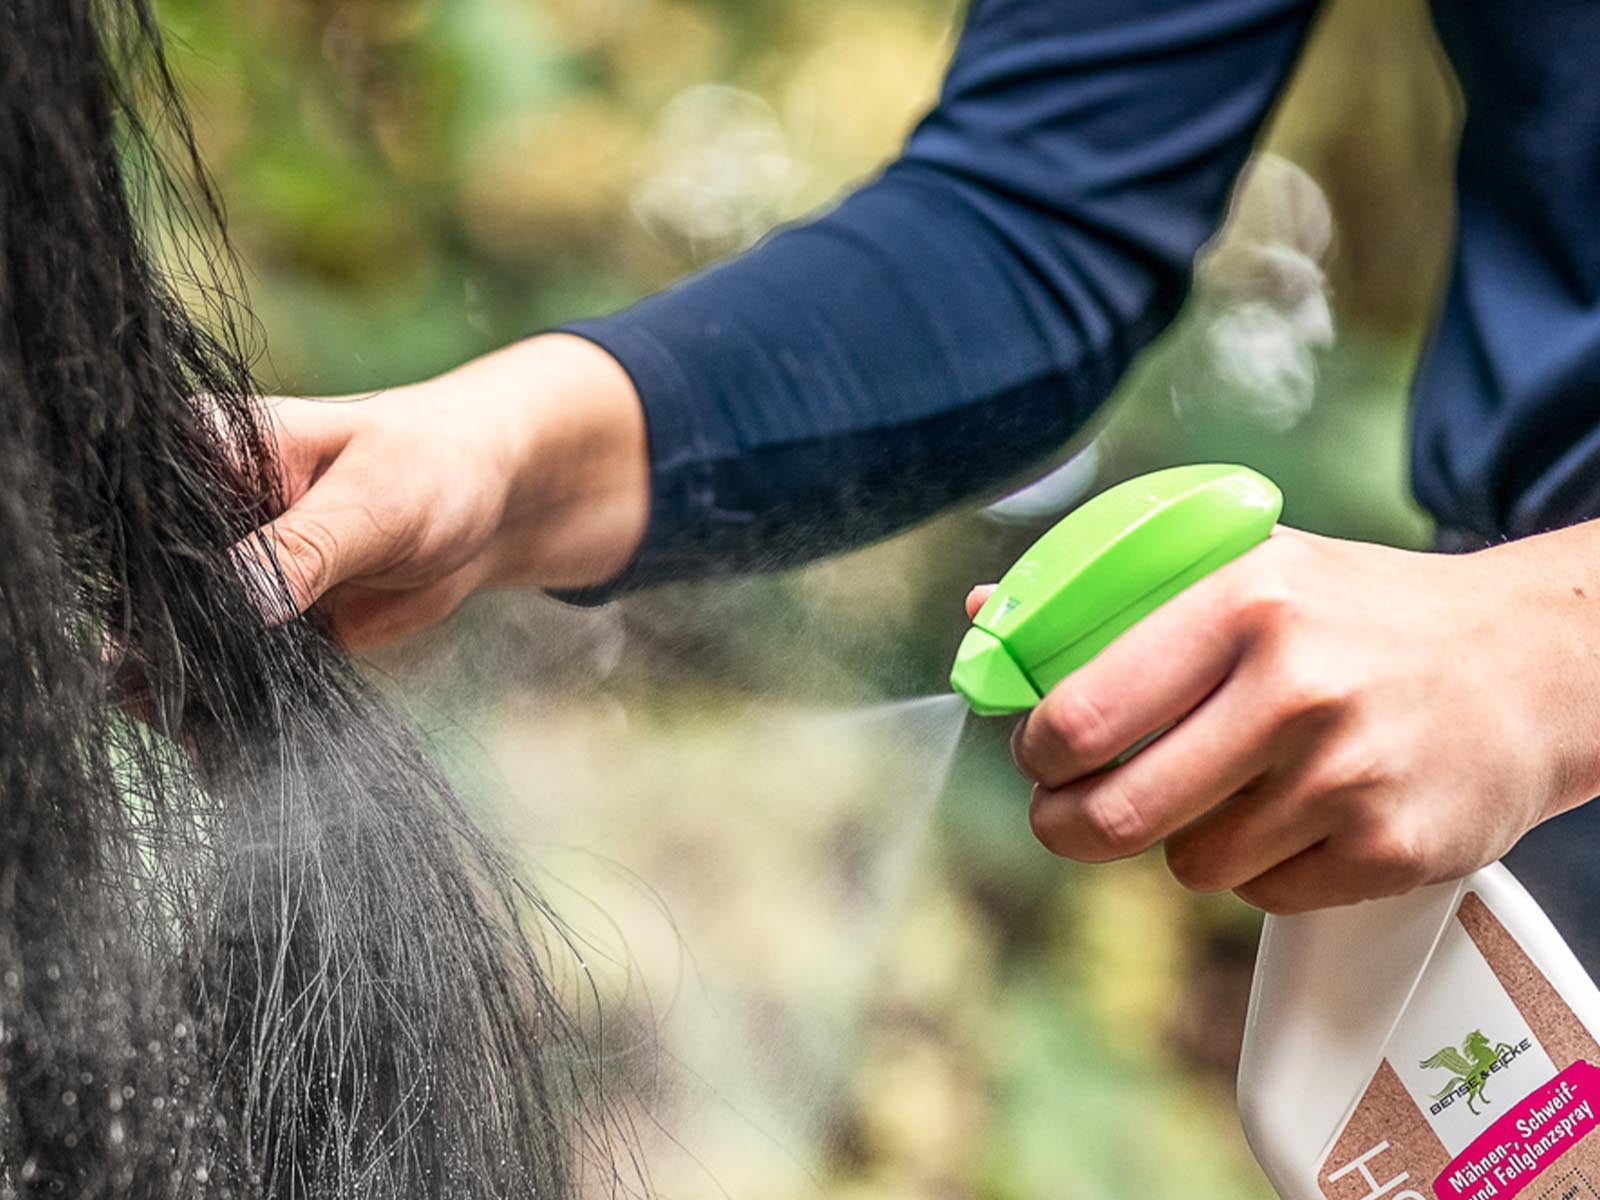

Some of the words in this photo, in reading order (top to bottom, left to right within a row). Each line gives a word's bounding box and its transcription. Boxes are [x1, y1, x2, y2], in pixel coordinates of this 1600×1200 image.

[1479, 1070, 1491, 1080] &
[1488, 1037, 1532, 1073] EICKE
[1448, 1141, 1520, 1193] Mähnen-,
[1516, 1081, 1578, 1138] Schweif-
[1493, 1099, 1595, 1187] Fellglanzspray
